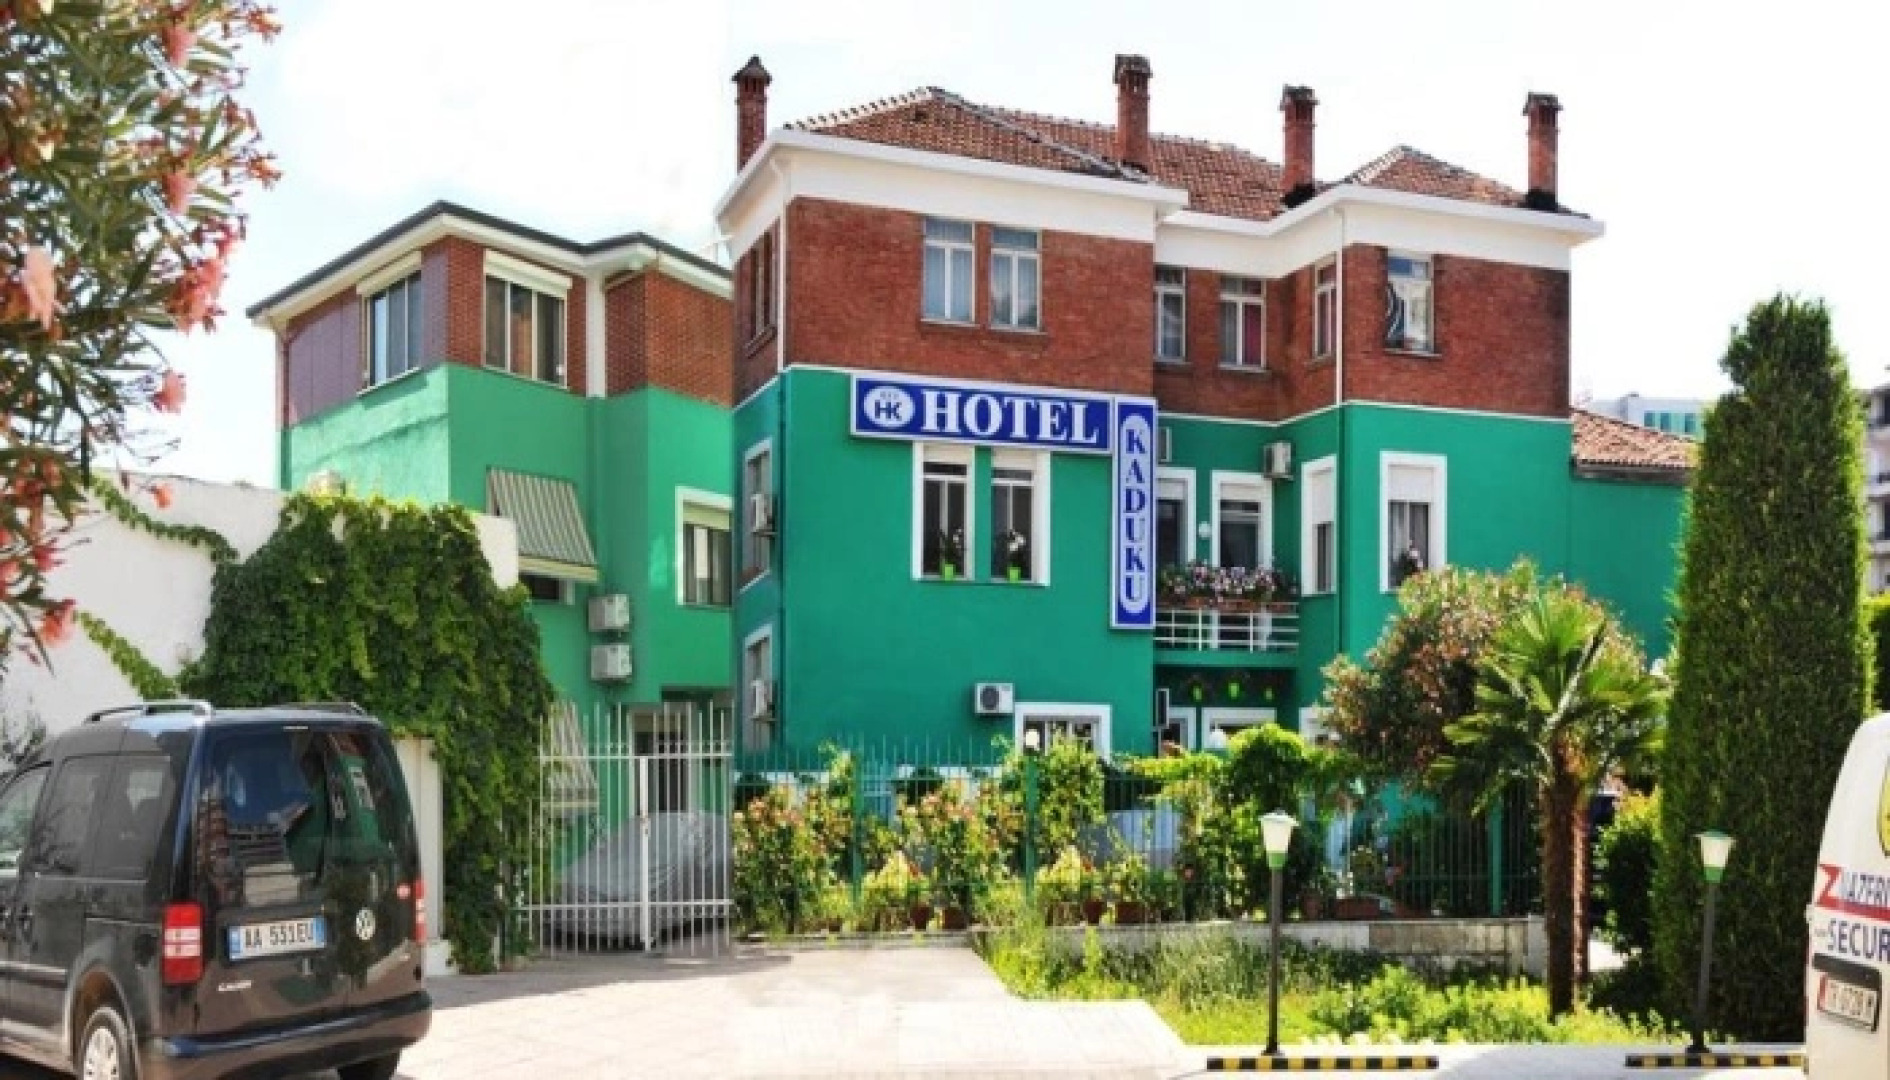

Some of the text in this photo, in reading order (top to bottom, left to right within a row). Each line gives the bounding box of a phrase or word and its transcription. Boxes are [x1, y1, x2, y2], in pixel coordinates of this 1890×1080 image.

[874, 388, 1098, 444] HK HOTEL
[1124, 428, 1146, 603] KADUKU
